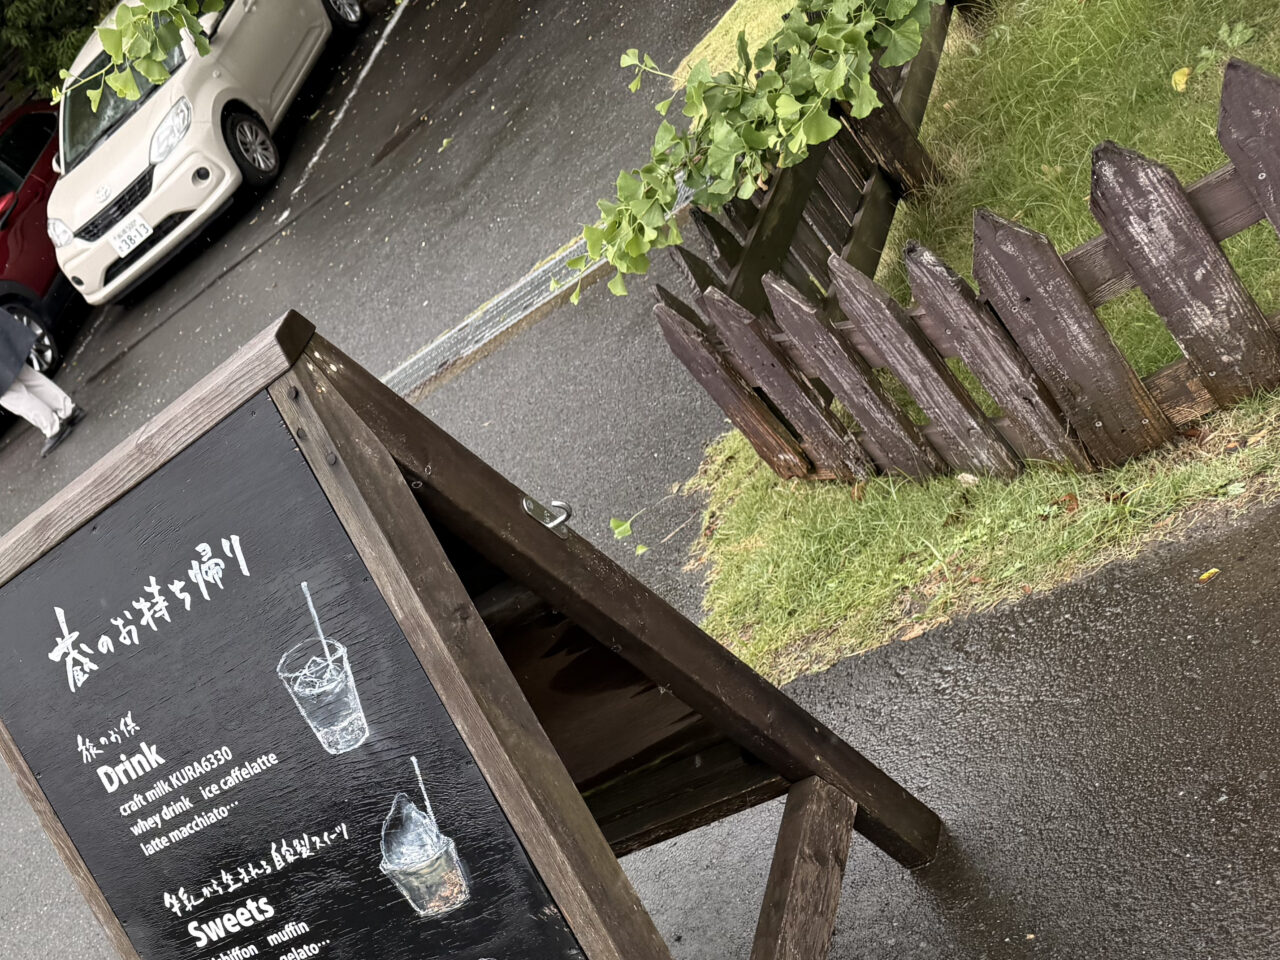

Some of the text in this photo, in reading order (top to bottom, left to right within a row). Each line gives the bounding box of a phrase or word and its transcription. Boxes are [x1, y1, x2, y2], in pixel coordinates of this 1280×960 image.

[48, 535, 250, 692] 蔵のお持ち帰り
[77, 710, 140, 763] 旅のお供
[97, 742, 166, 793] Drink
[120, 745, 233, 817] craft milk KURA6330
[130, 752, 279, 837] whey drink ice caffelatte
[140, 833, 170, 857] latte
[187, 896, 275, 948] Sweets
[266, 920, 310, 946] muffin
